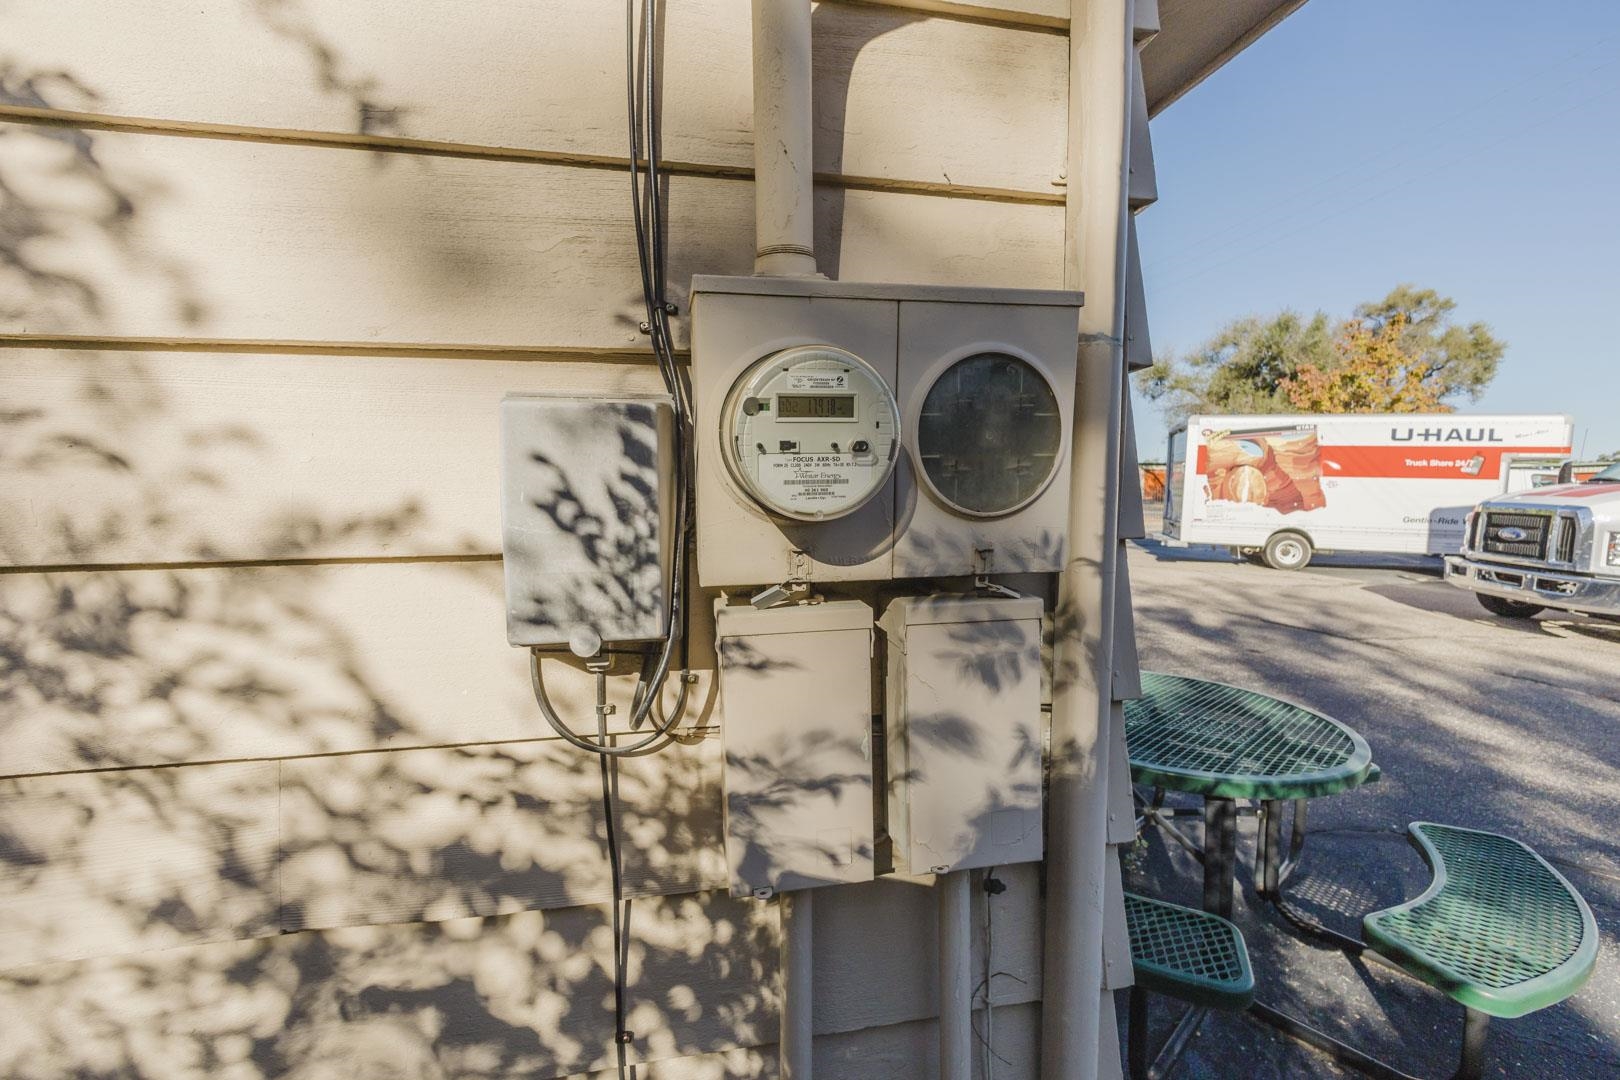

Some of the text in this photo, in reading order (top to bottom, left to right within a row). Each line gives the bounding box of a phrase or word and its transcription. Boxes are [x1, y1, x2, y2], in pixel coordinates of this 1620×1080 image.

[1391, 428, 1503, 442] U-HAUL
[1405, 459, 1428, 467] Truck
[1429, 459, 1453, 468] Share
